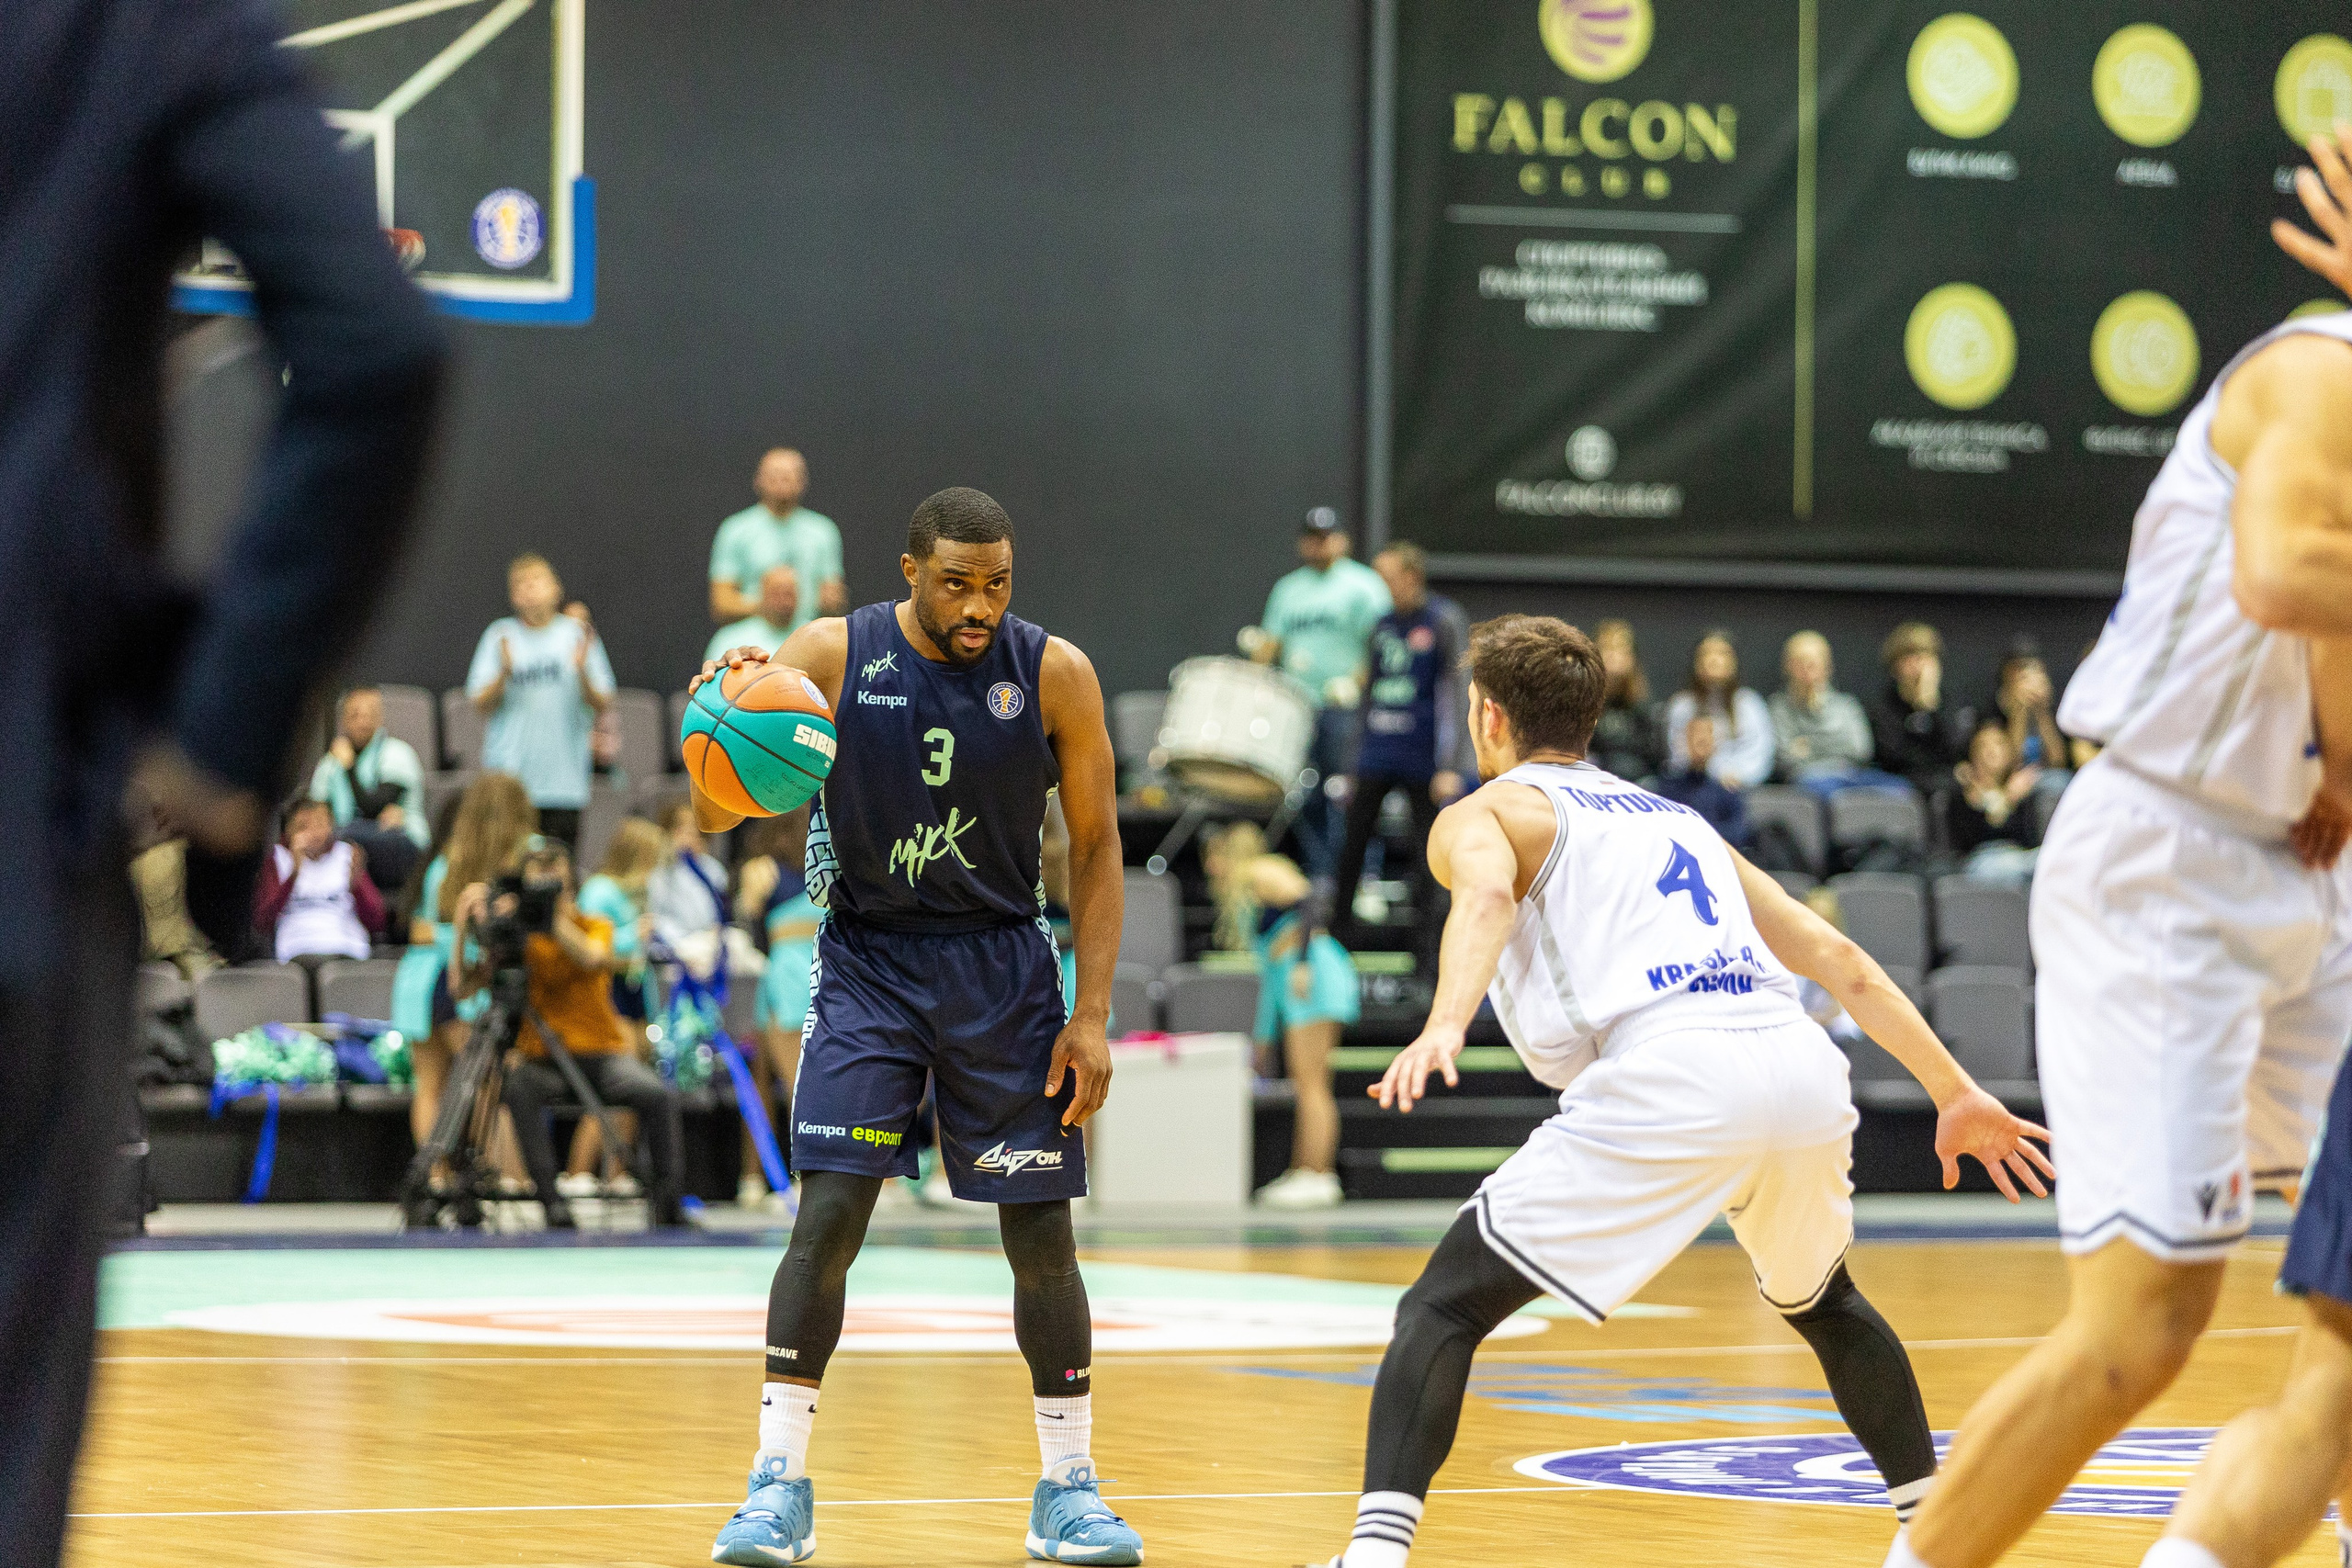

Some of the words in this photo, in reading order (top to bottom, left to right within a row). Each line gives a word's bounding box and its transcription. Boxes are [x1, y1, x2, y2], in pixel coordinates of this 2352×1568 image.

[1453, 93, 1737, 164] FALCON
[857, 691, 908, 709] Kempa
[921, 728, 955, 786] 3
[1656, 837, 1718, 926] 4
[797, 1121, 846, 1138] Kempa
